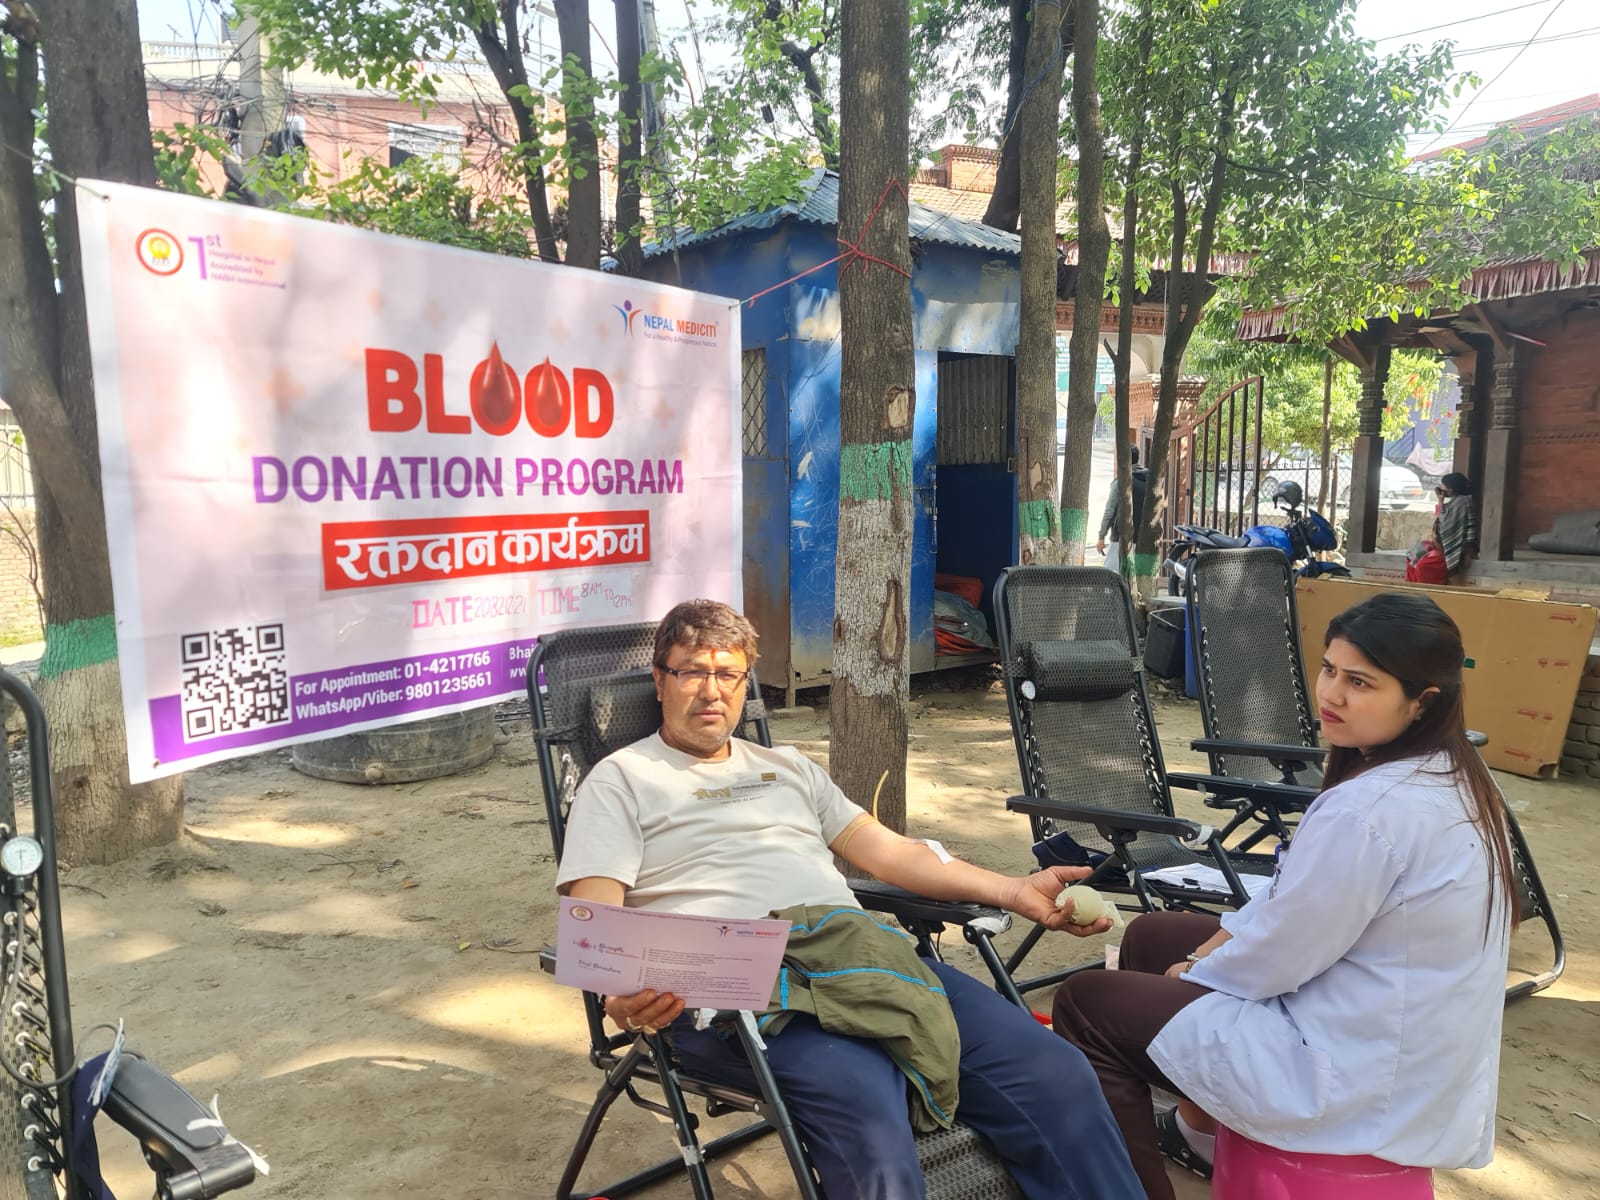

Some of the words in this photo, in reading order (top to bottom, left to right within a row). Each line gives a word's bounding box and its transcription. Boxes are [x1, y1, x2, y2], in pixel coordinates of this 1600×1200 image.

[644, 314, 674, 332] NEPAL
[676, 319, 717, 338] MEDICITI
[364, 339, 614, 438] BLOOD
[251, 456, 503, 503] DONATION
[516, 457, 684, 497] PROGRAM
[334, 529, 499, 582] रक्तदान
[502, 515, 645, 565] कार्यक्रम
[412, 595, 473, 629] DATE
[537, 586, 580, 616] TIME
[295, 680, 318, 697] For
[320, 666, 401, 695] Appointment:
[404, 651, 491, 679] 01-4217766
[296, 689, 403, 720] WhatsApp/Viber:
[405, 672, 492, 701] 9801235661
